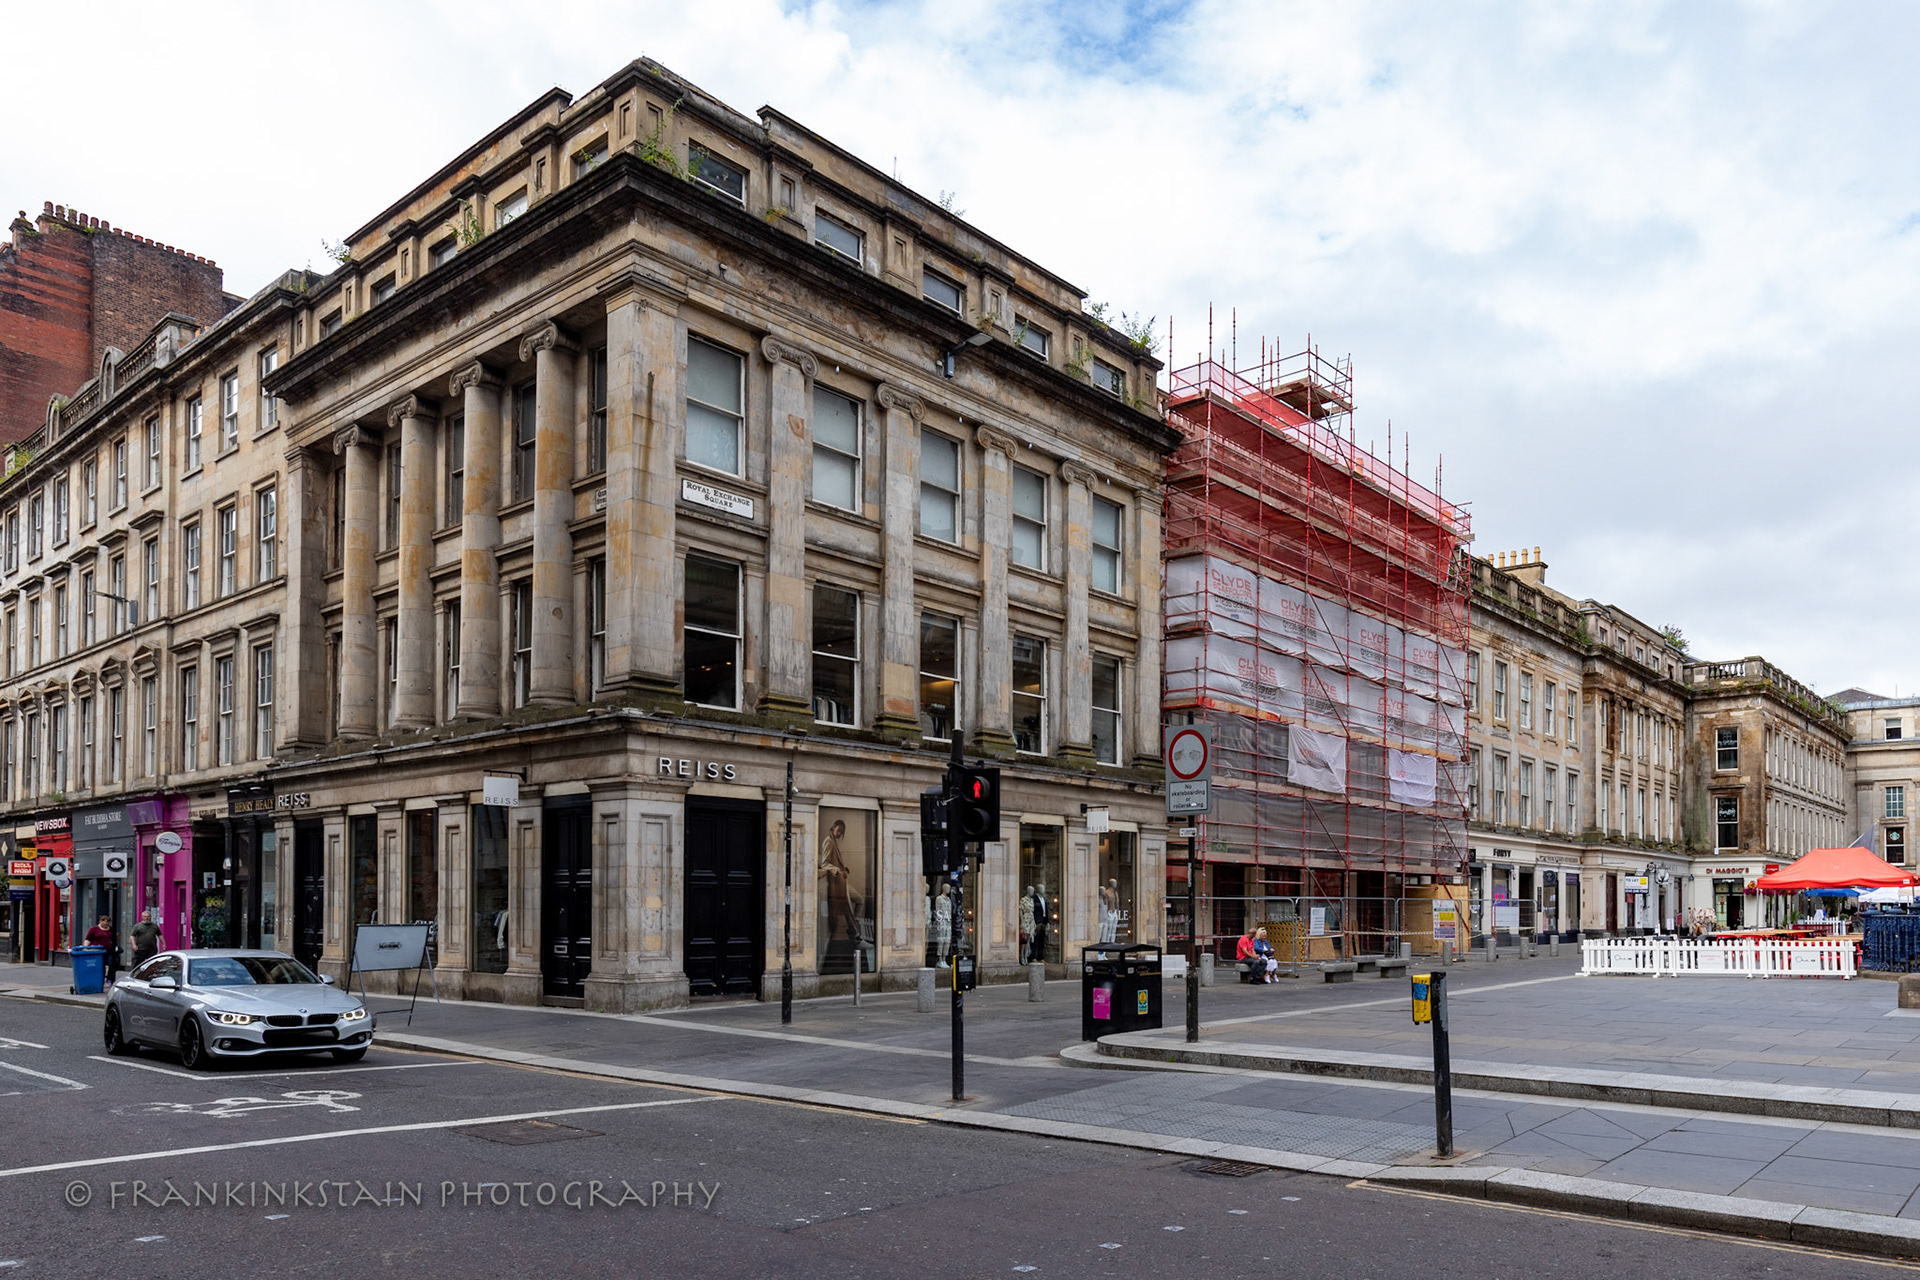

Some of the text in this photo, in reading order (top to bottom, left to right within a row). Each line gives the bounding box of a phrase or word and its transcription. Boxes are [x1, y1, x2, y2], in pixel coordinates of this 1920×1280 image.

[686, 481, 750, 507] ROYAL EXCHANGE
[704, 493, 733, 509] SQUARE
[1211, 568, 1251, 591] CLYDE
[1212, 581, 1253, 600] SCAFFOLDING
[1281, 598, 1316, 620] CLYDE
[1360, 629, 1390, 647] CLYDE
[1412, 647, 1438, 660] CLYDE
[1238, 657, 1276, 678] CLYDE
[1301, 677, 1337, 694] CLYDE
[659, 757, 736, 780] REISS
[235, 799, 274, 813] HENRY HEALY
[278, 791, 306, 808] REISS
[484, 796, 518, 806] REISS
[34, 817, 68, 831] NEWSBOX
[92, 813, 108, 824] BUDDHA
[109, 811, 122, 823] STORE
[1493, 848, 1511, 858] FORTY
[1107, 909, 1129, 920] SALE
